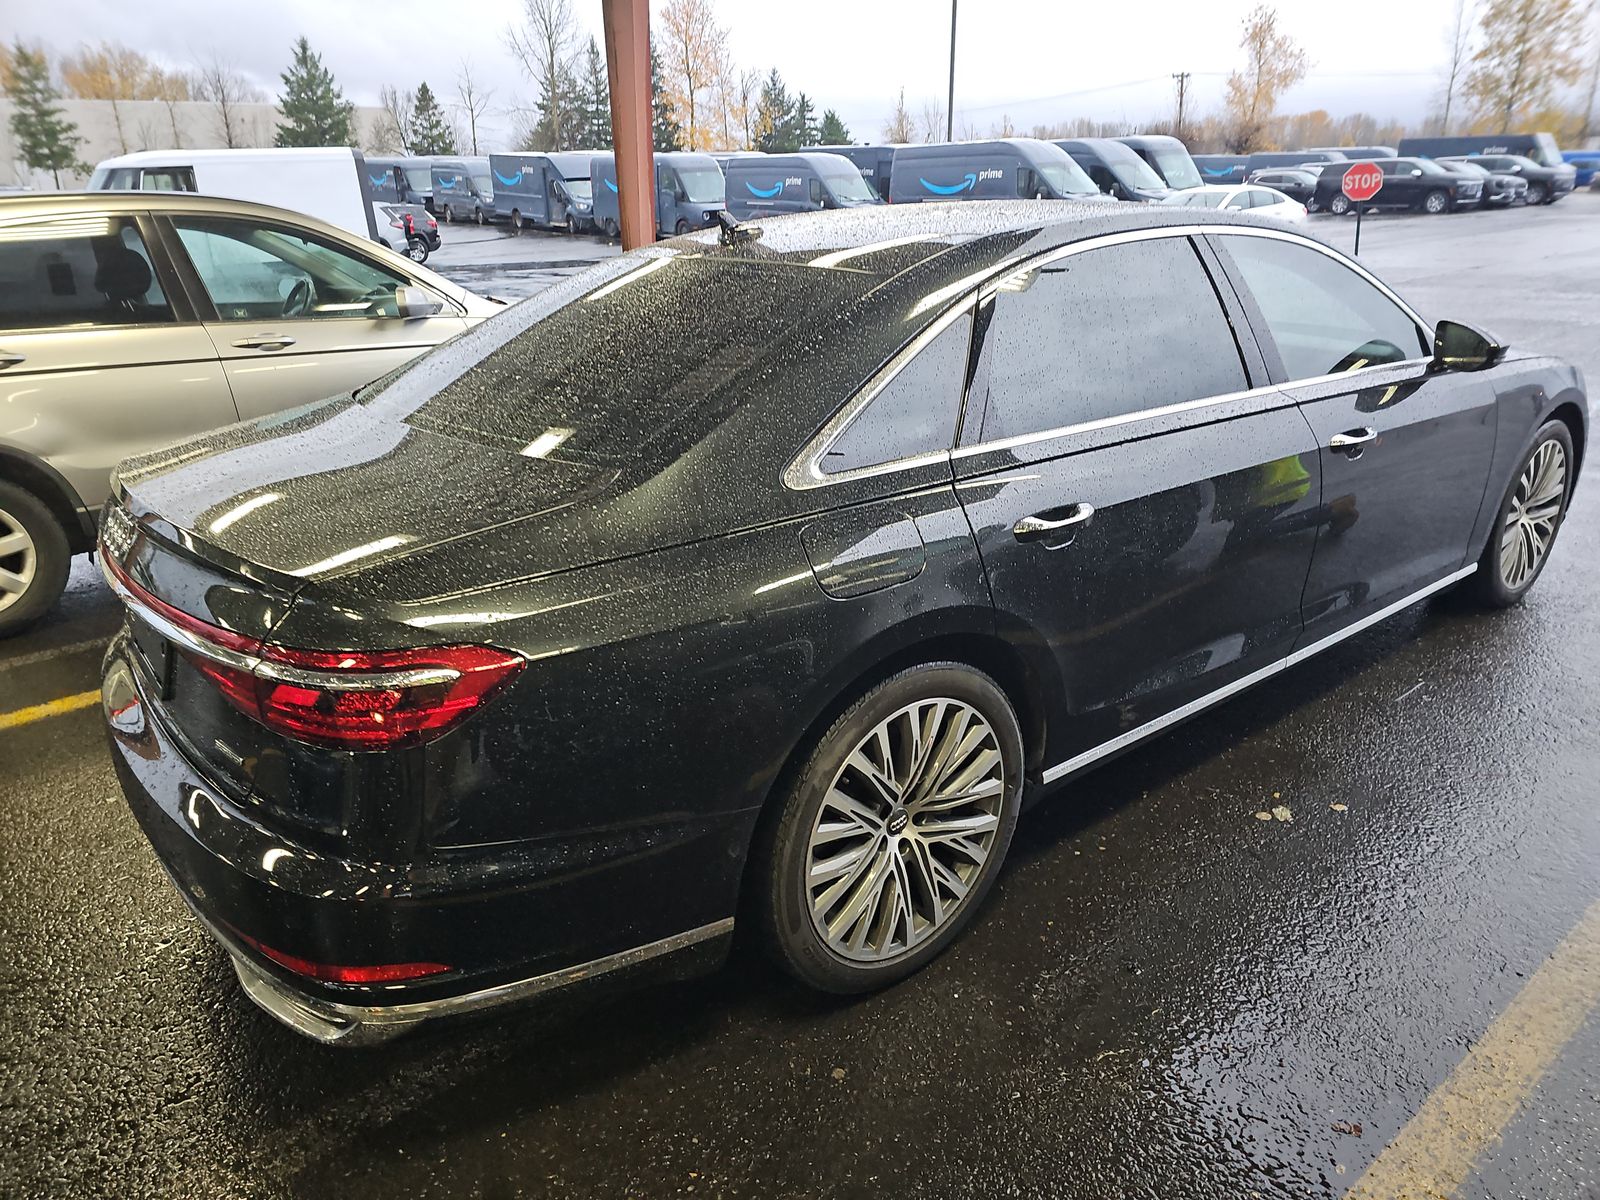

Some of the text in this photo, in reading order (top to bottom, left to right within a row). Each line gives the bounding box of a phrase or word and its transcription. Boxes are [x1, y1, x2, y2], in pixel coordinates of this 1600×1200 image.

[1483, 146, 1508, 155] prime
[979, 168, 1003, 182] prime
[785, 176, 802, 187] prime
[1345, 173, 1381, 190] STOP
